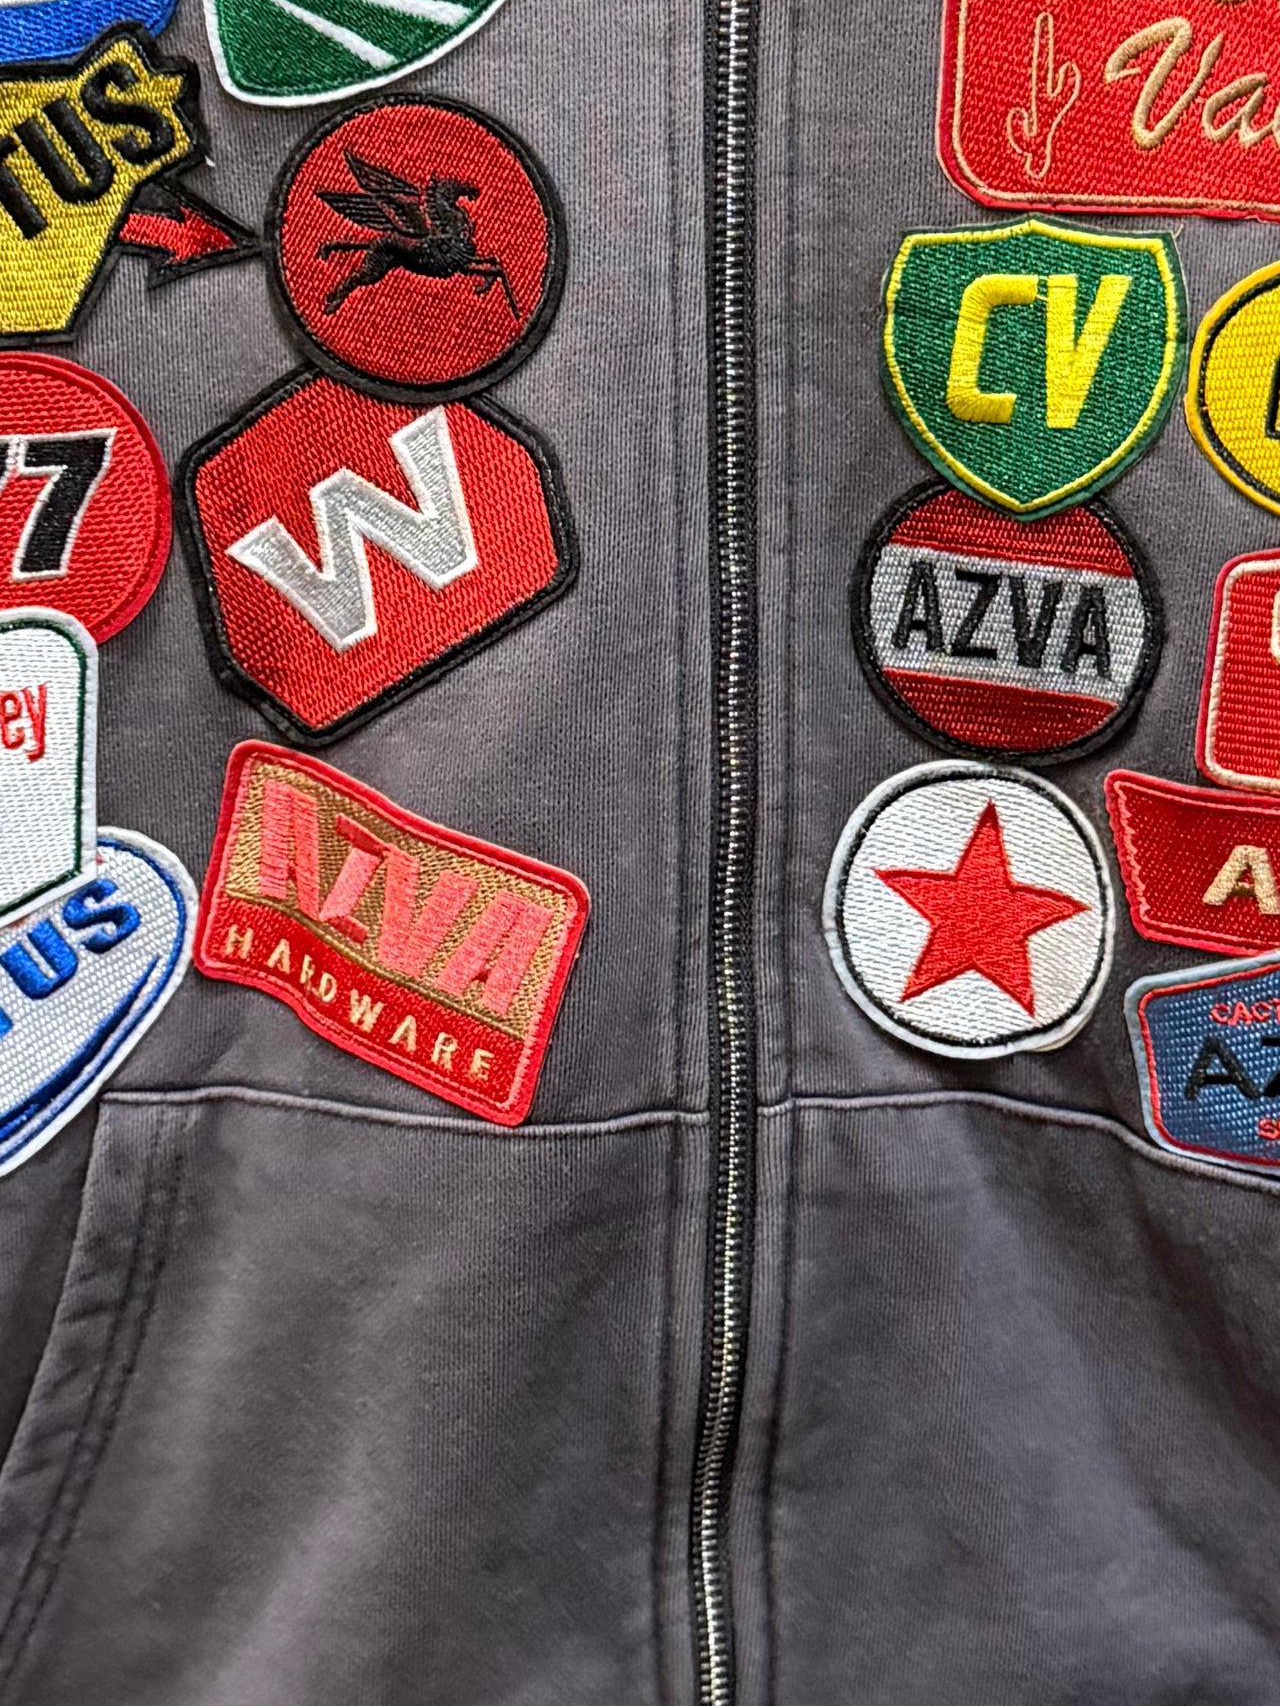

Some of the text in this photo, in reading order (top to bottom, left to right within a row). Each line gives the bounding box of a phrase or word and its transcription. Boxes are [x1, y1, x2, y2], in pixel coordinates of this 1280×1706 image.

[945, 274, 1130, 430] CV
[227, 404, 478, 653] W
[892, 562, 1112, 681] AZVA
[259, 778, 555, 1015] AZVA
[224, 925, 495, 1081] HARDWARE
